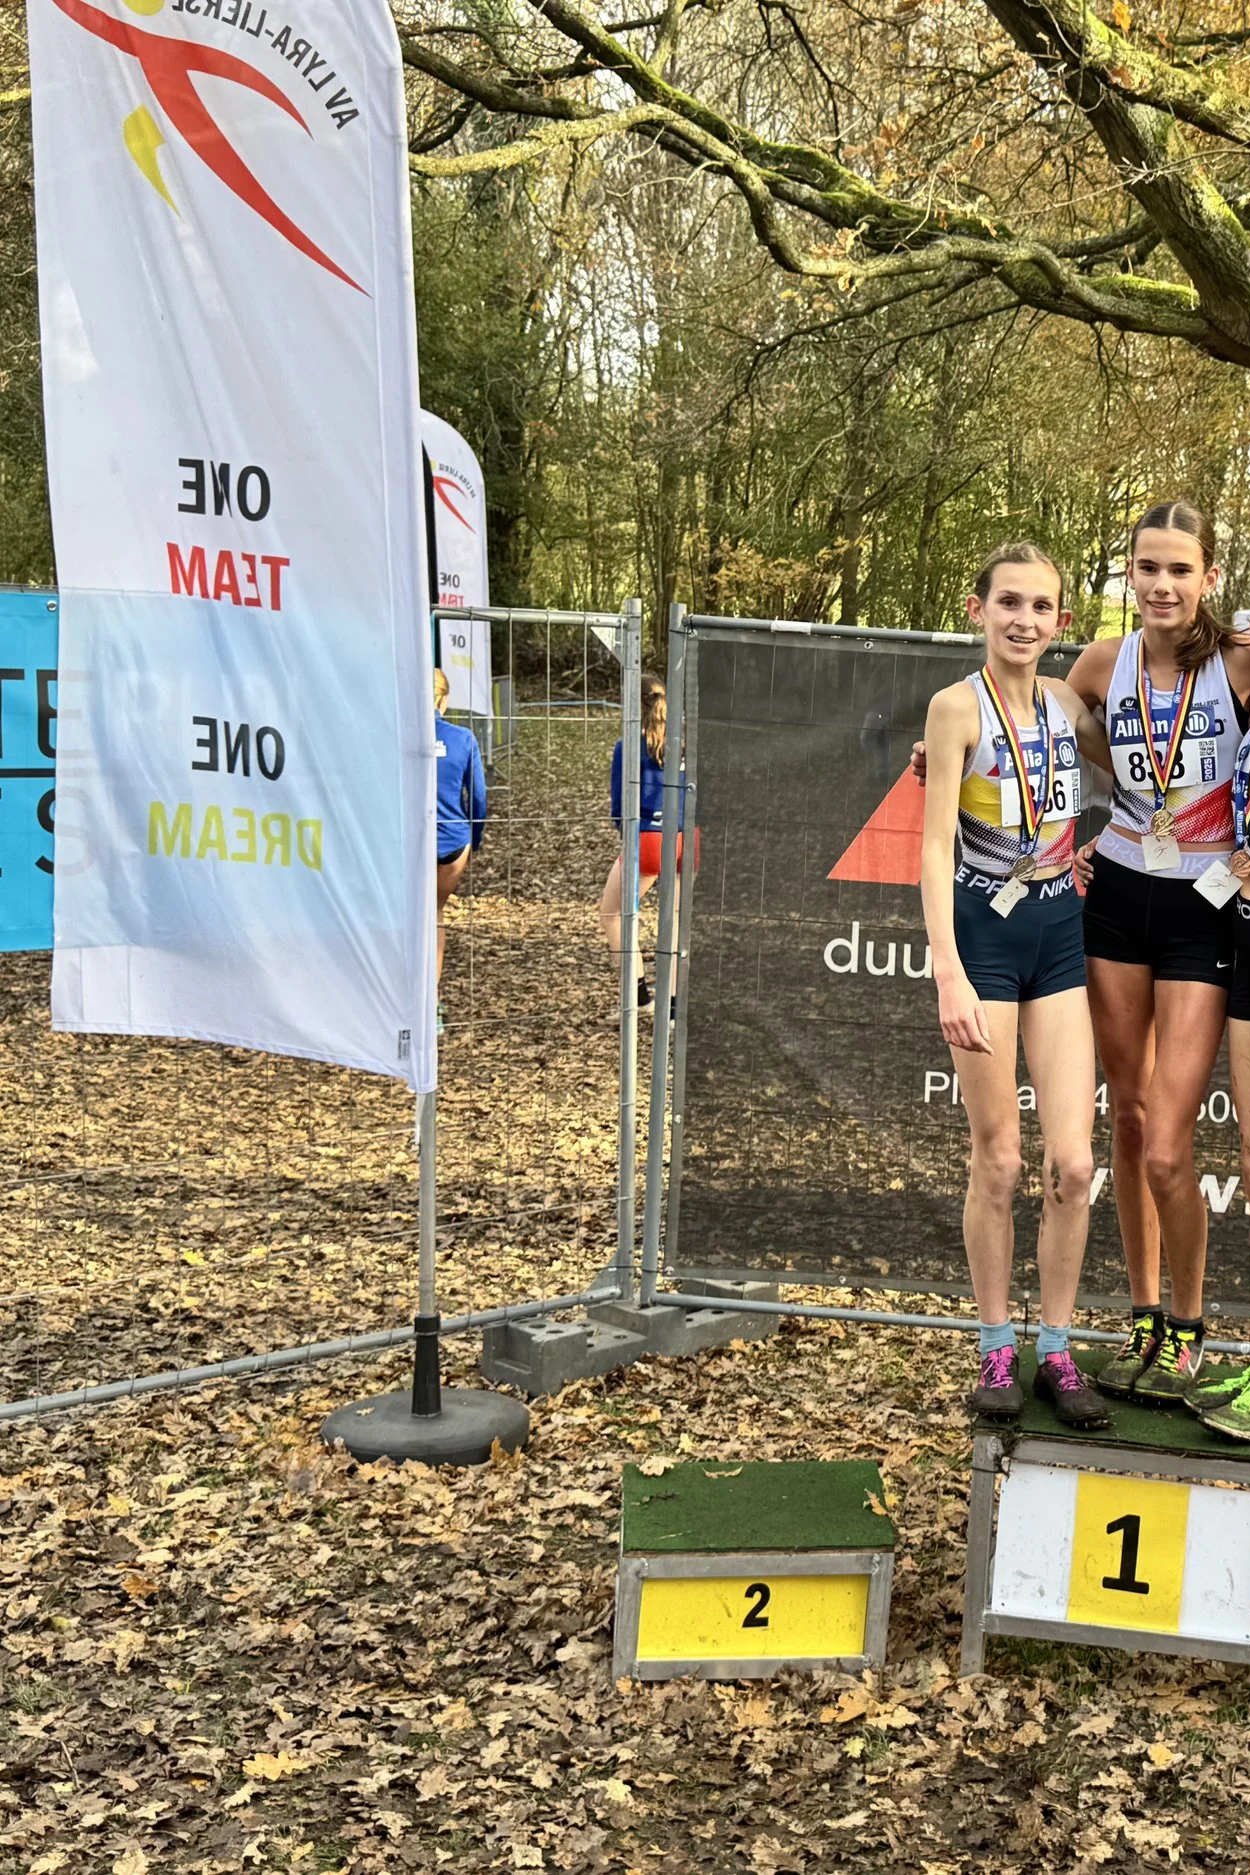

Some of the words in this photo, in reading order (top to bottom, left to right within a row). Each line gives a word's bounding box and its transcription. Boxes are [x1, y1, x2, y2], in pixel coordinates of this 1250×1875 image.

[1204, 757, 1213, 780] 2025
[1102, 1514, 1149, 1595] 1
[742, 1582, 770, 1628] 2
